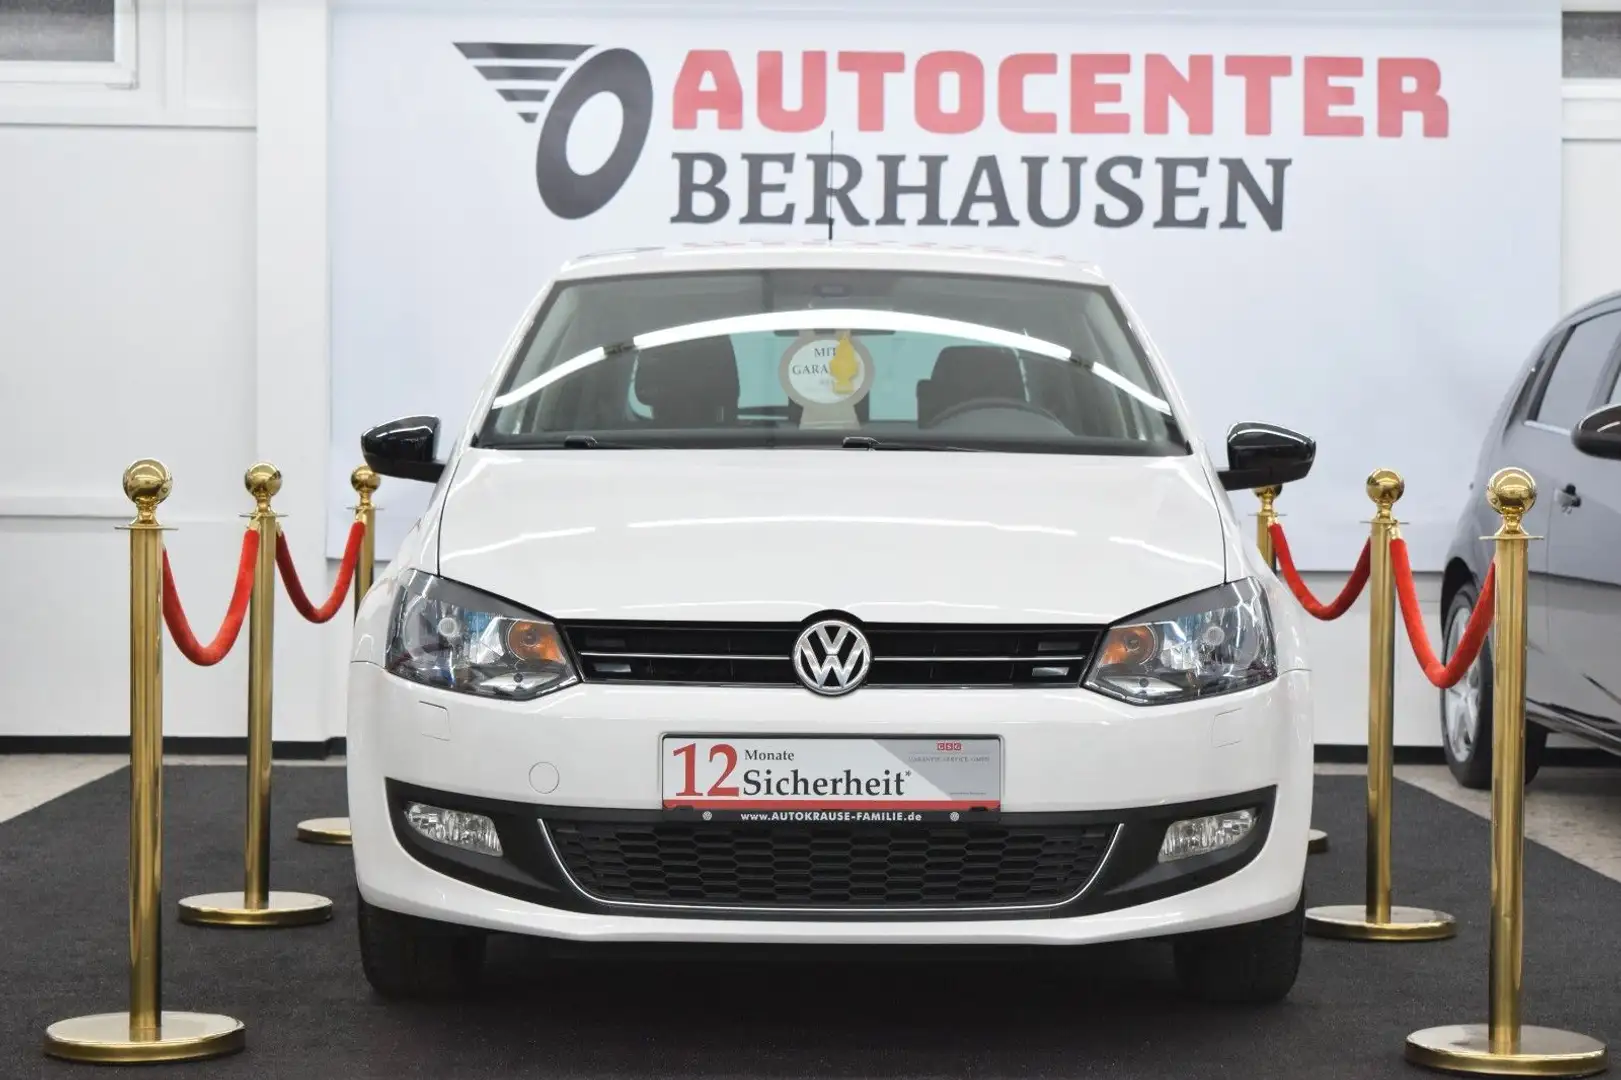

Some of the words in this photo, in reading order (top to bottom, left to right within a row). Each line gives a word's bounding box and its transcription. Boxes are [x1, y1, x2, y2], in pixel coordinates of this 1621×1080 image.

[672, 48, 1450, 138] AUTOCENTER
[797, 621, 868, 692] VW
[672, 742, 740, 797] 12
[744, 749, 795, 762] Monate
[740, 811, 923, 822] www.AUTOKRAUSE-FAMILIE.de
